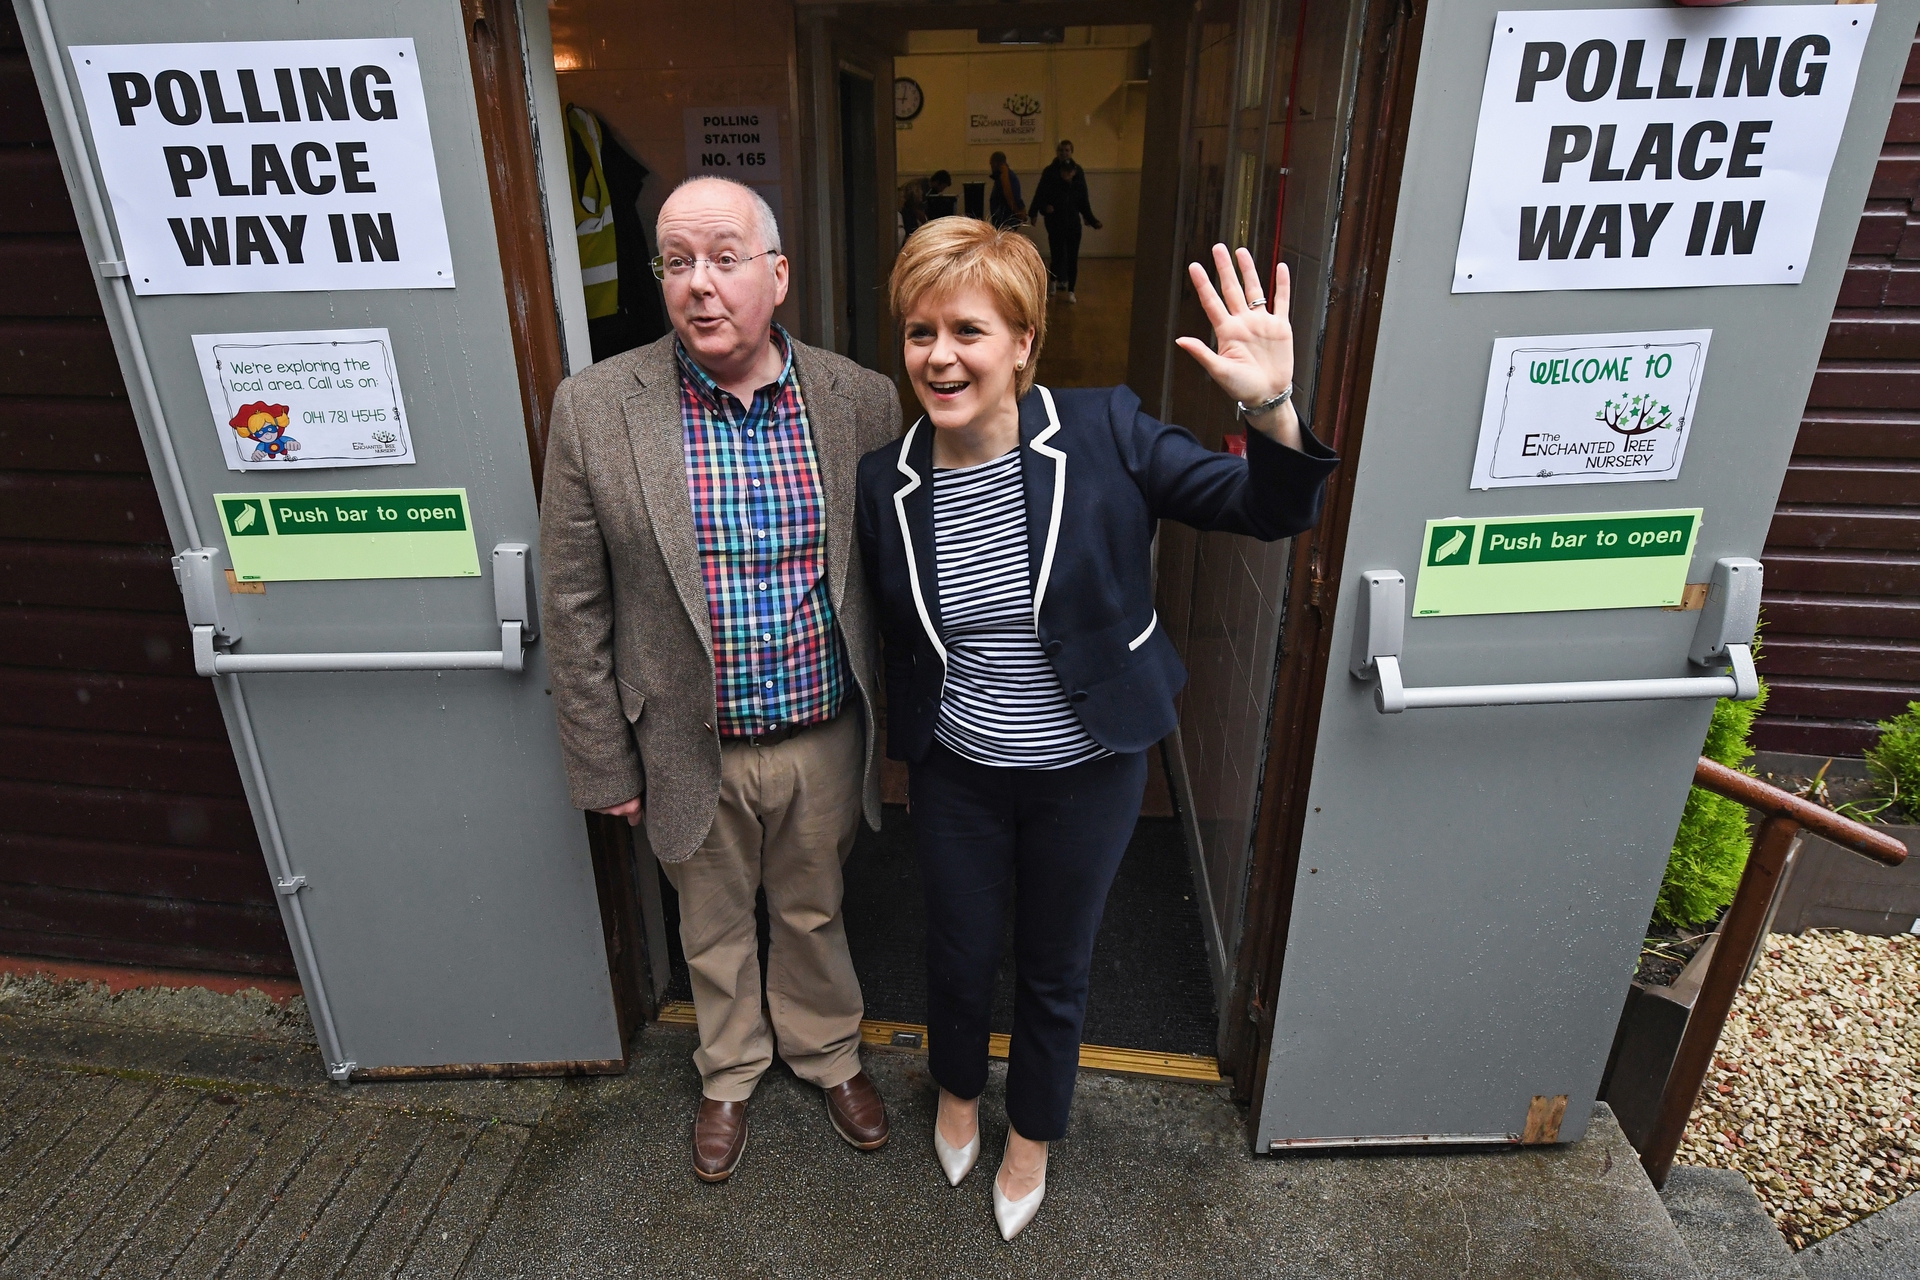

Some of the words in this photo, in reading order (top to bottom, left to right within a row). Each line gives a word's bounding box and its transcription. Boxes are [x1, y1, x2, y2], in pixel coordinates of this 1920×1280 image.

[1515, 34, 1831, 103] POLLING
[108, 65, 398, 126] POLLING
[703, 115, 759, 127] POLLING
[970, 115, 1016, 127] ENCHANTED
[1002, 126, 1036, 134] NURSERY
[704, 133, 760, 145] STATION
[701, 153, 731, 167] NO.
[736, 152, 766, 166] 165
[1542, 120, 1773, 183] PLACE
[163, 142, 376, 197] PLACE
[1518, 203, 1674, 261] WAY
[1685, 200, 1766, 257] IN
[167, 214, 307, 267] WAY
[328, 213, 400, 263] IN
[230, 361, 273, 375] We're
[276, 359, 341, 376] exploring
[343, 358, 371, 371] the
[1529, 356, 1633, 386] WELCOME
[229, 378, 264, 392] local
[267, 379, 305, 391] area.
[308, 376, 333, 390] Call
[336, 378, 354, 389] us
[358, 377, 379, 389] on:
[302, 410, 326, 425] 0141
[328, 410, 349, 424] 781
[351, 408, 387, 423] 4545
[1522, 433, 1615, 457] ENCHANTED
[1623, 435, 1656, 453] TREE
[1541, 432, 1561, 443] The
[1585, 454, 1653, 469] NURSERY
[279, 506, 328, 523] Push
[335, 506, 368, 522] bar
[376, 506, 398, 521] to
[406, 507, 457, 523] open
[1489, 532, 1542, 551] Push
[1550, 531, 1588, 549] bar
[1596, 530, 1618, 546] to
[1627, 528, 1682, 549] open
